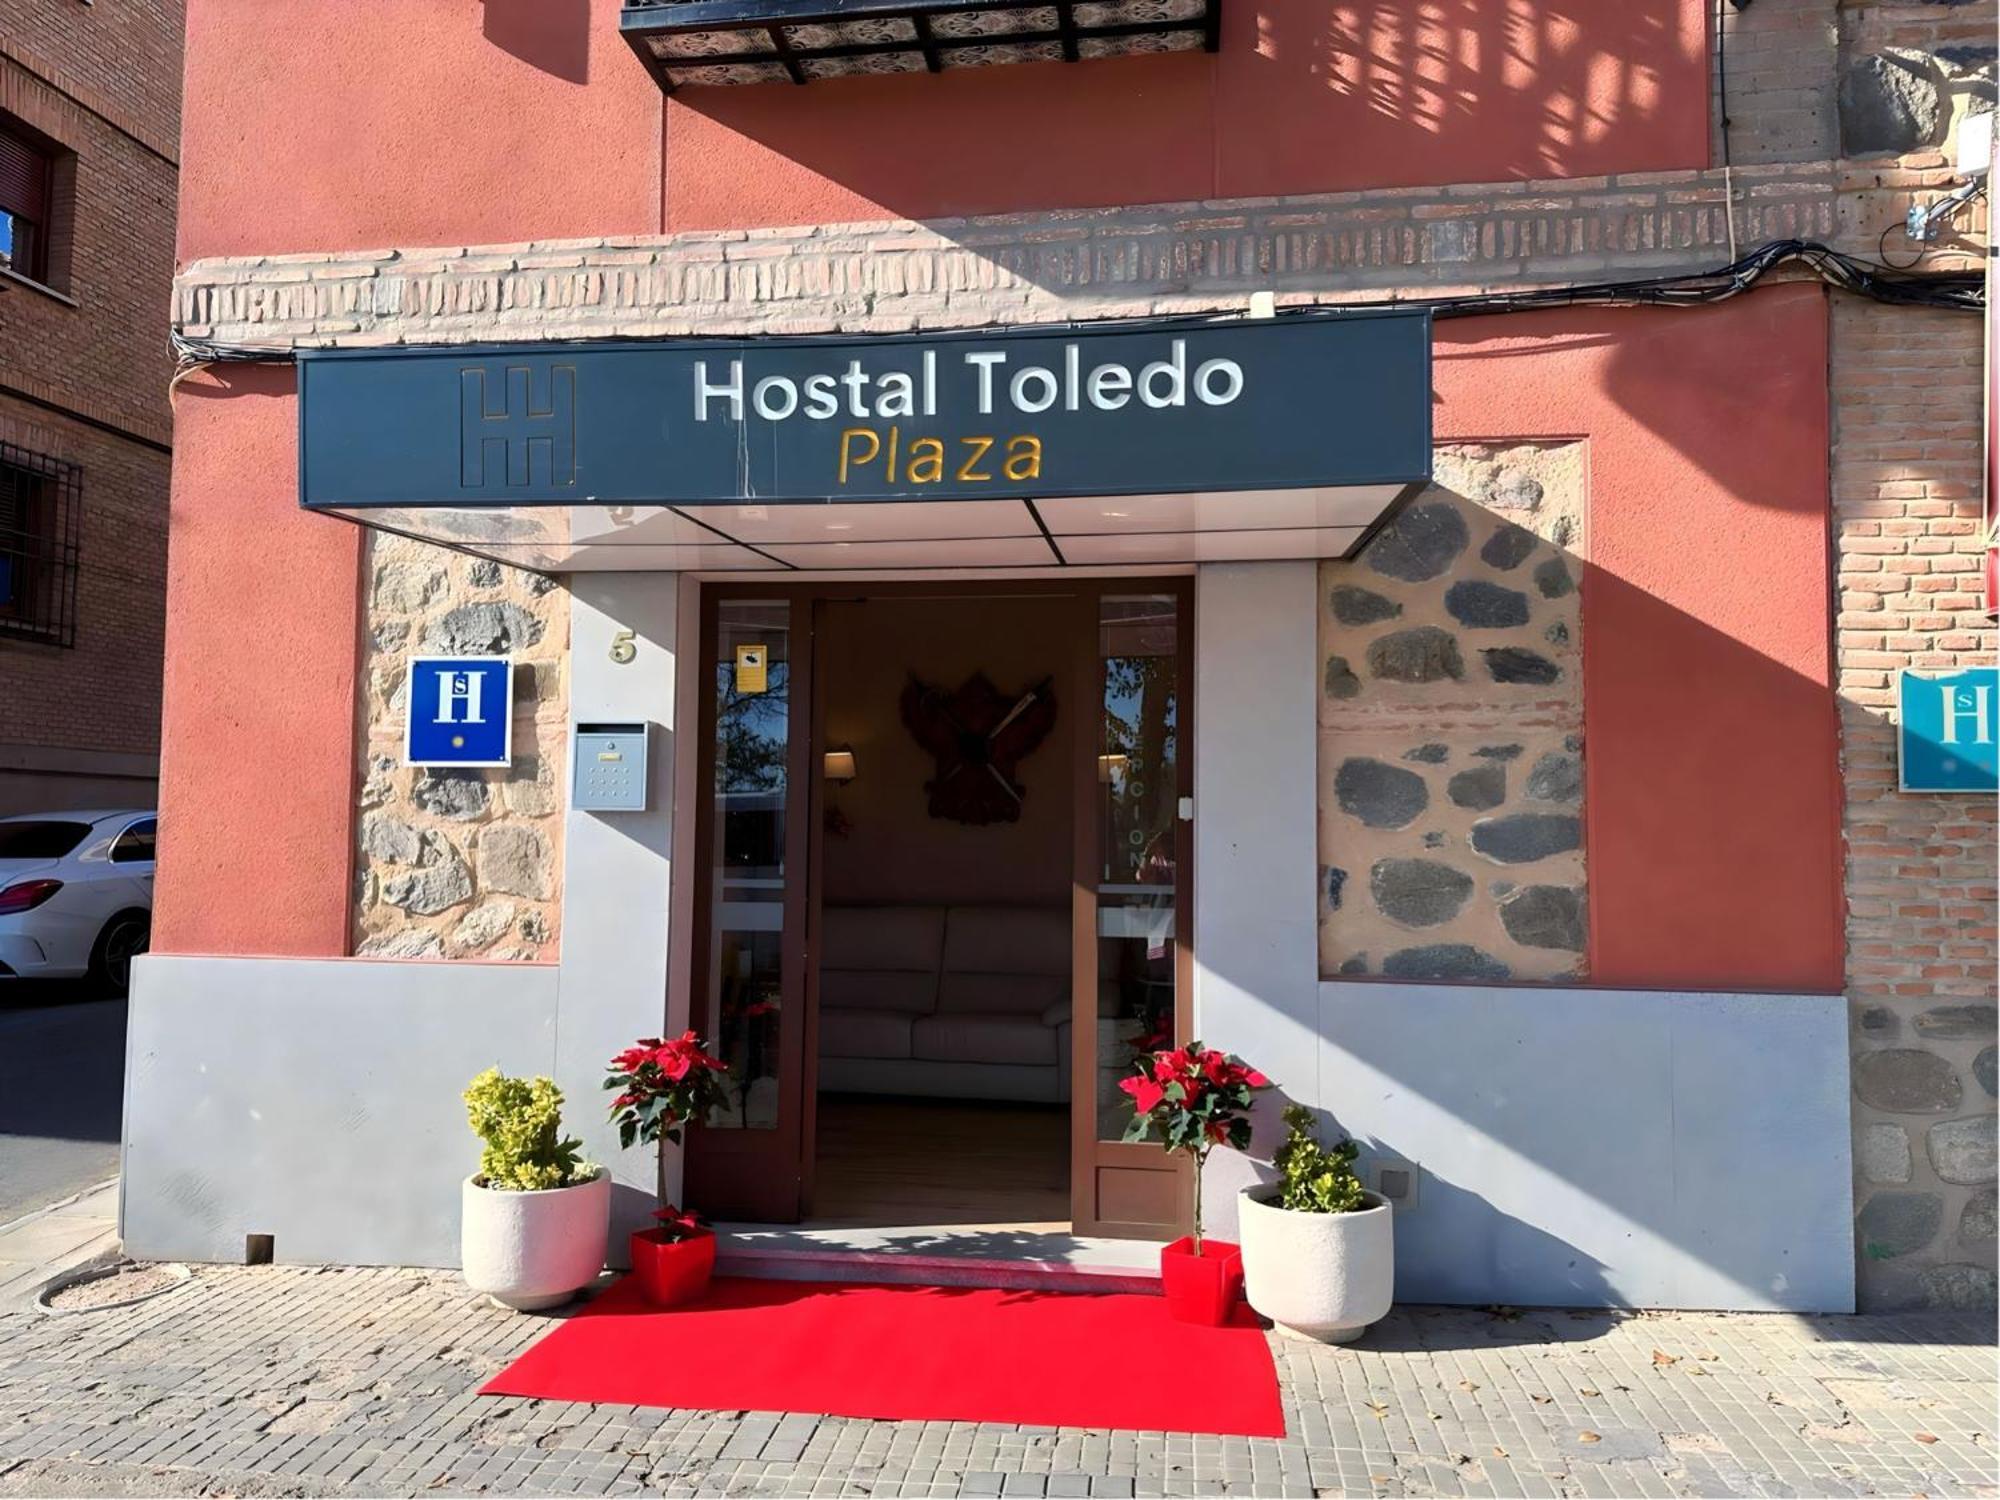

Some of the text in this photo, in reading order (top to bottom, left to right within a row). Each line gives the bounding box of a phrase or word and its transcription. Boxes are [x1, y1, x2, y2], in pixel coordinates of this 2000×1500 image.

[694, 339, 1244, 421] Hostal Toledo
[838, 426, 1044, 484] Plaza
[608, 630, 638, 665] 5
